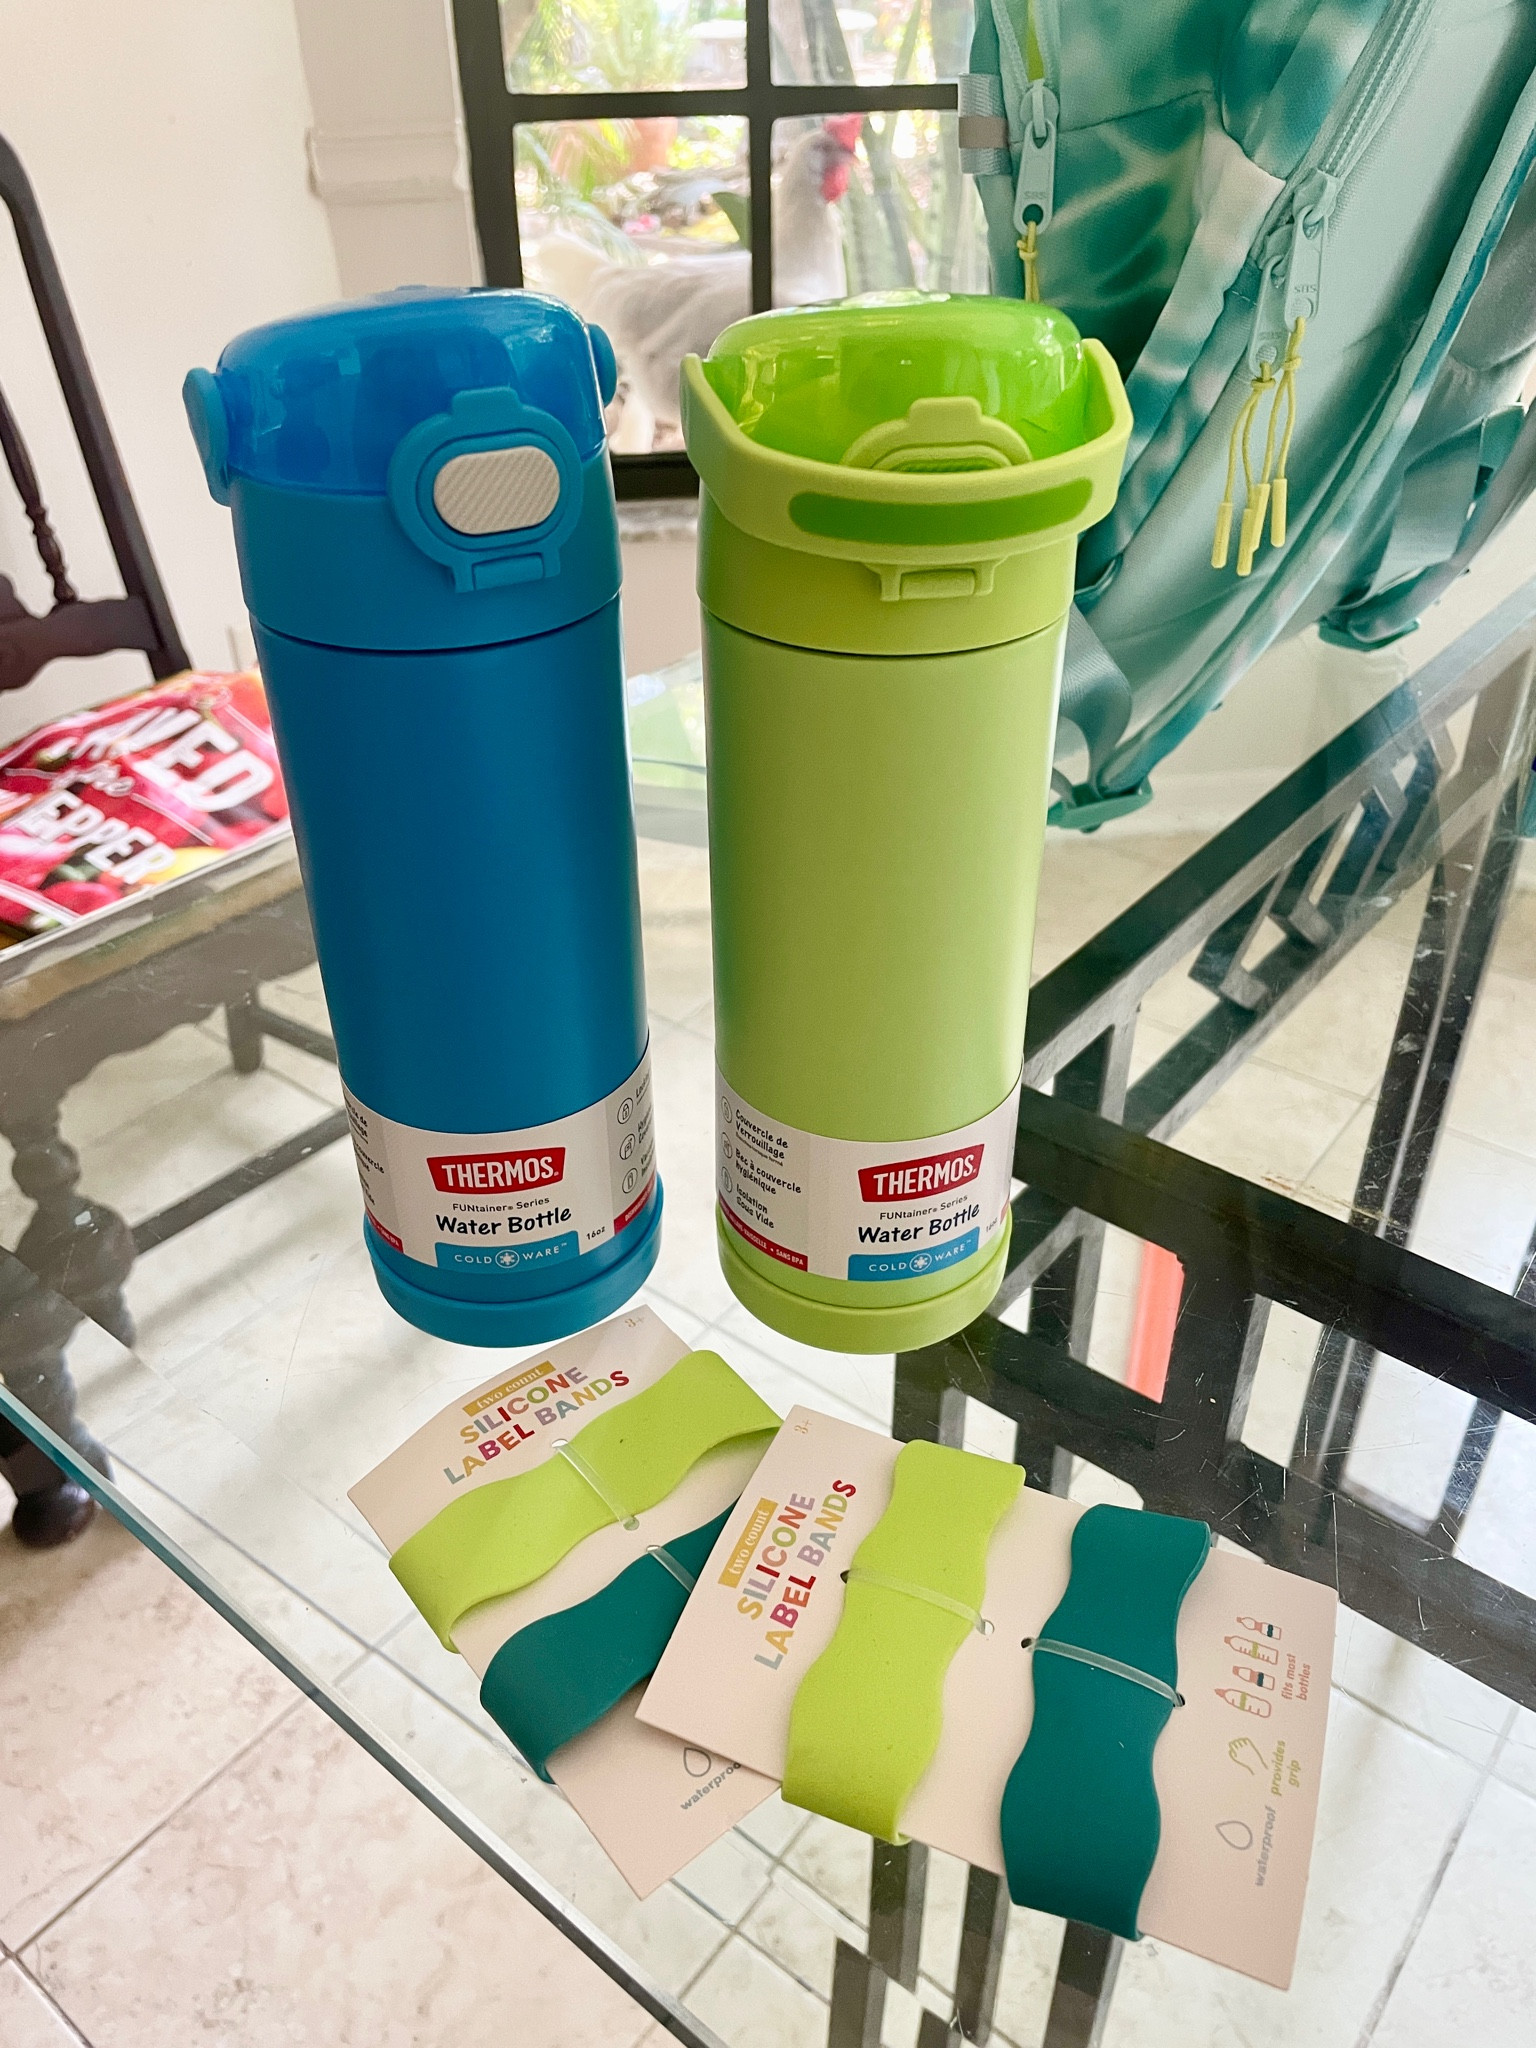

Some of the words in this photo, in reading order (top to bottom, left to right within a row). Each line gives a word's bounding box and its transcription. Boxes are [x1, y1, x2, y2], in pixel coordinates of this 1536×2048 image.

[736, 1109, 774, 1142] Couvercle
[776, 1138, 789, 1149] de
[736, 1120, 785, 1159] Verrouillage
[736, 1148, 748, 1166] Bec
[756, 1167, 802, 1194] couvercle
[736, 1160, 776, 1195] hygiénique
[516, 1197, 550, 1209] Series
[736, 1183, 768, 1214] Isolation
[736, 1196, 754, 1216] Sous
[755, 1210, 775, 1229] Vide
[940, 1194, 968, 1212] Series
[436, 1214, 502, 1235] Water
[508, 1206, 572, 1233] Bottle
[586, 1226, 606, 1241] 16oz
[858, 1221, 924, 1244] Water
[929, 1202, 980, 1235] Bottle
[454, 1254, 493, 1265] COLD
[868, 1261, 907, 1273] COLD
[460, 1367, 588, 1444] SILICONE
[476, 1391, 504, 1410] two
[505, 1368, 545, 1392] count
[443, 1423, 535, 1485] LABEL
[534, 1370, 630, 1426] BANDS
[728, 1549, 750, 1576] two
[743, 1509, 770, 1546] count
[737, 1493, 816, 1621] SILICONE
[754, 1575, 817, 1671] LABEL
[796, 1479, 857, 1568] BANDS
[1286, 1653, 1296, 1676] most
[1296, 1663, 1311, 1701] bottles
[1281, 1677, 1293, 1701] fits
[680, 1761, 741, 1810] waterproo
[1270, 1739, 1286, 1797] provides
[1288, 1759, 1302, 1788] grip
[1255, 1804, 1277, 1888] waterproof
